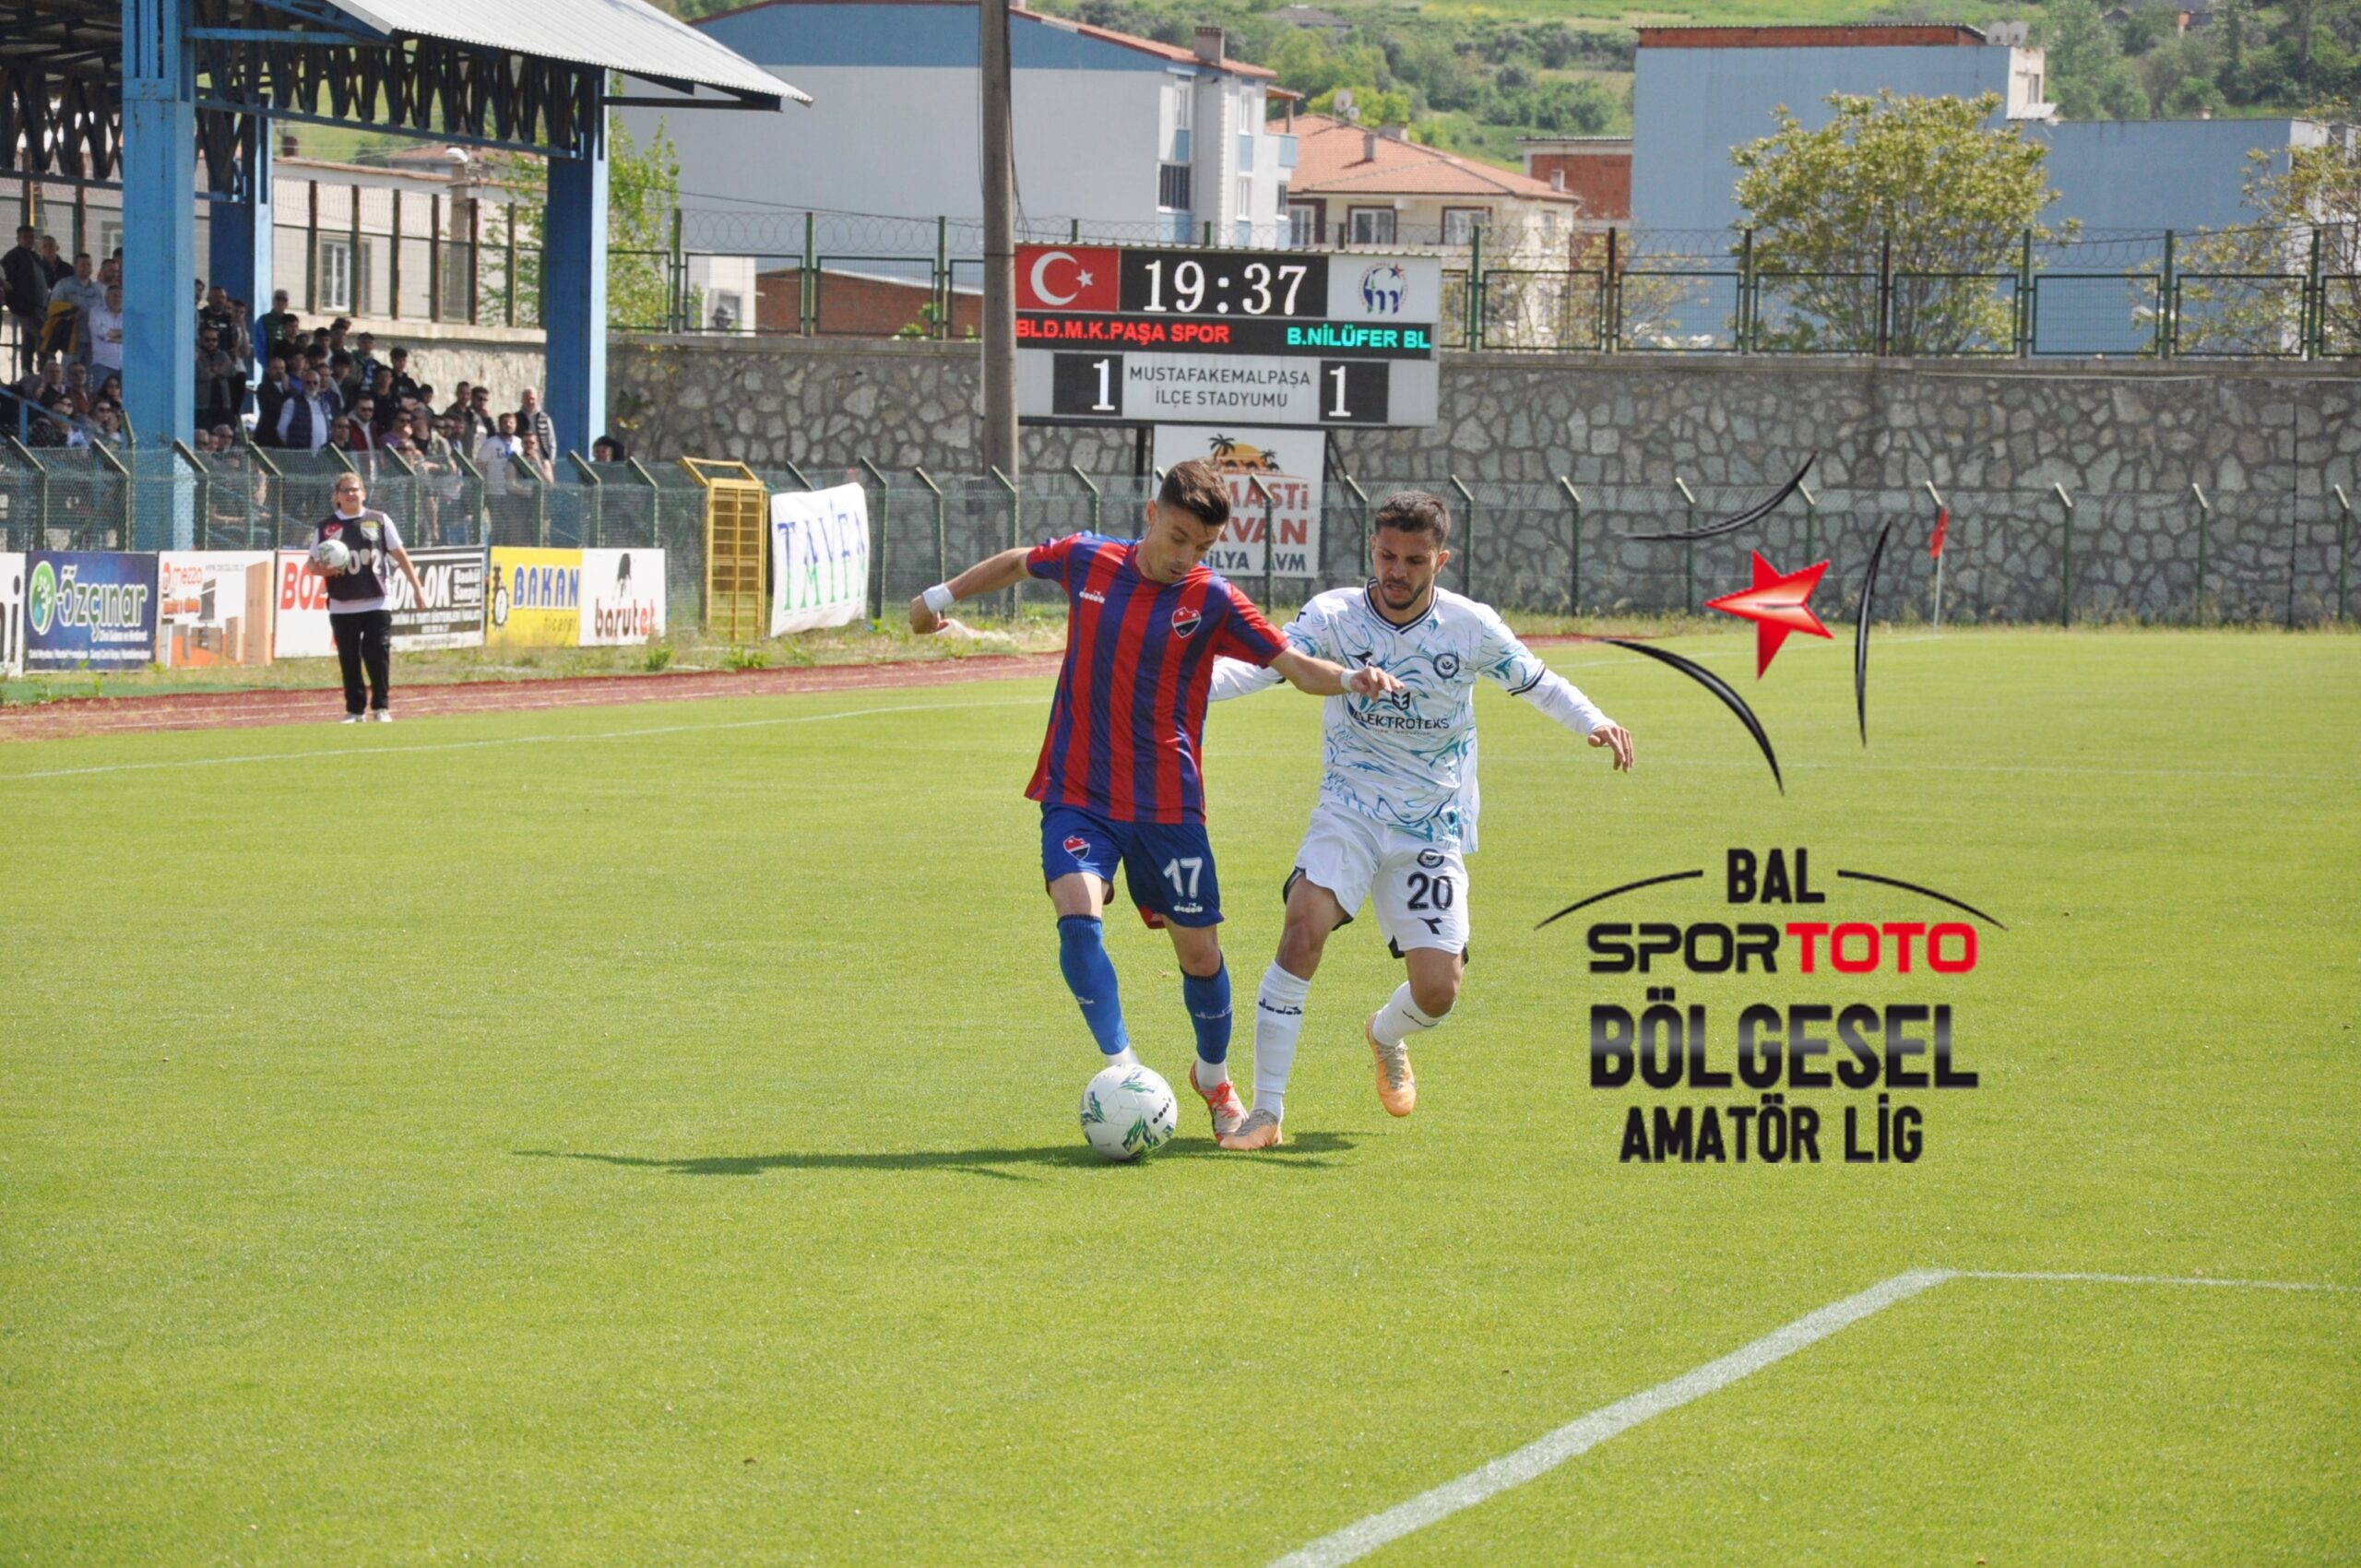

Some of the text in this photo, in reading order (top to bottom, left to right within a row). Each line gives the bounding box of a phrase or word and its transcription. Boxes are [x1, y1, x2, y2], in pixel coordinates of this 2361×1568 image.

[1143, 259, 1308, 315] 19:37
[1015, 318, 1230, 346] BLD.M.K.PAŞA SPOR
[1287, 323, 1431, 349] B.NİLÜFER BL
[1092, 359, 1115, 410] 1
[1130, 366, 1311, 389] MUSTAFAKEMALPAŞA
[1156, 386, 1287, 408] İLÇE STADYUMU
[1328, 365, 1352, 417] 1
[1202, 551, 1250, 570] iLYA
[513, 565, 580, 607] BAKAN
[1163, 857, 1203, 898] 17
[1407, 872, 1453, 911] 20
